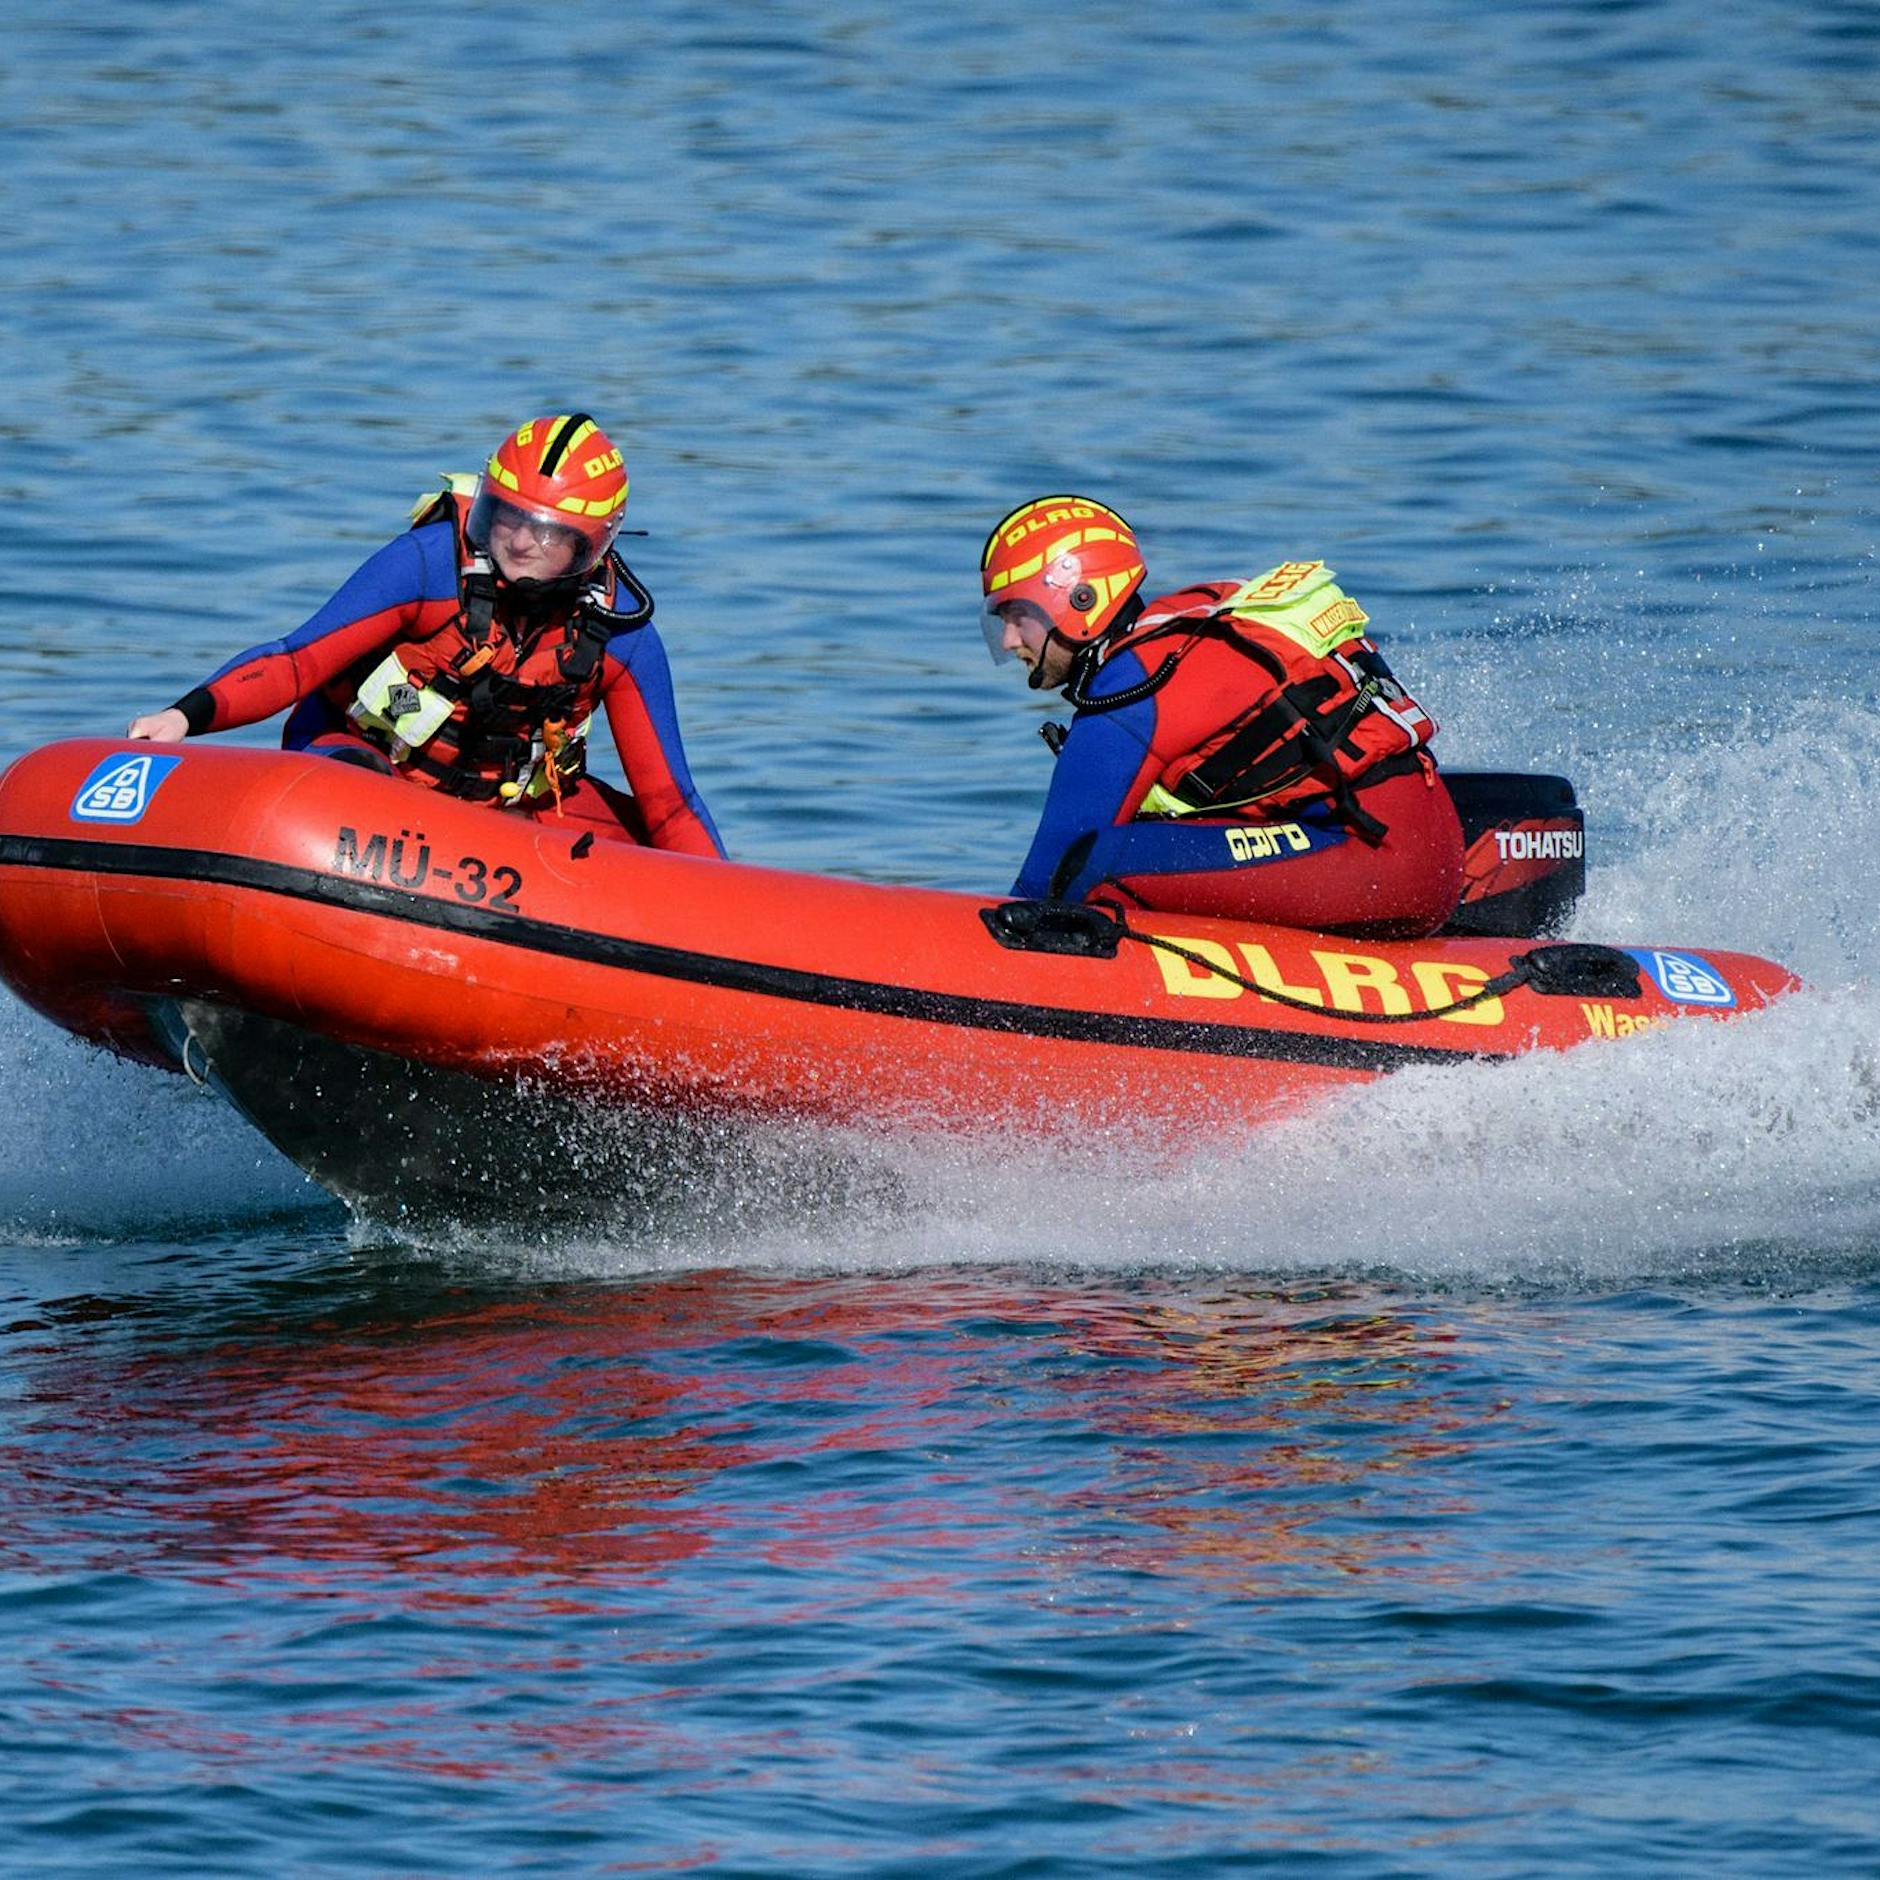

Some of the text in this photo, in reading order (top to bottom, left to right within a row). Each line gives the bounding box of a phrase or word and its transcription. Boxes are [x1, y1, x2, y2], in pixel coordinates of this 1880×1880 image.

[584, 448, 624, 479] DLR
[1005, 506, 1095, 548] DLRG
[1494, 830, 1583, 860] TOHATSU
[334, 826, 522, 913] MÜ-32
[1150, 934, 1505, 1026] DLRG
[1579, 1002, 1668, 1040] Was
